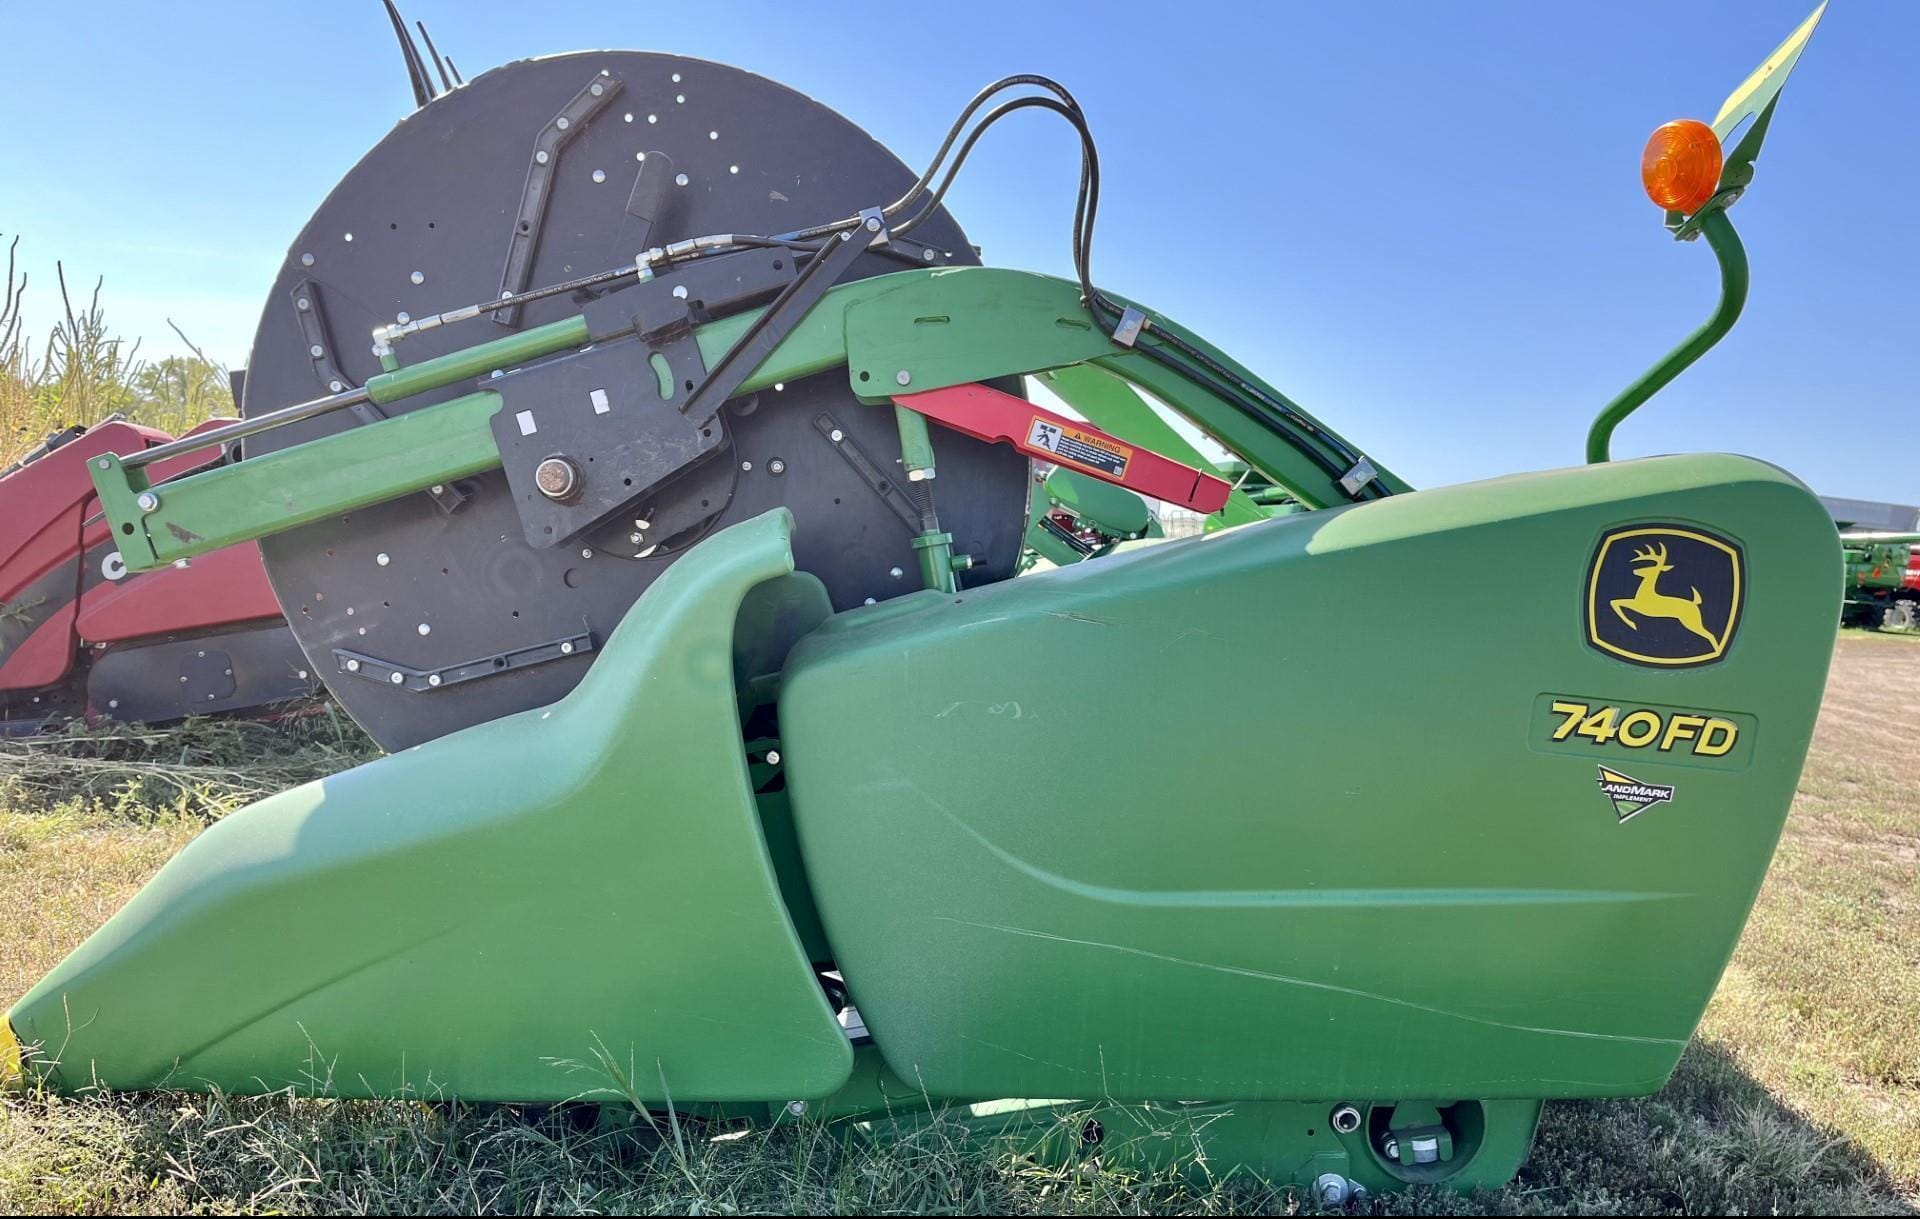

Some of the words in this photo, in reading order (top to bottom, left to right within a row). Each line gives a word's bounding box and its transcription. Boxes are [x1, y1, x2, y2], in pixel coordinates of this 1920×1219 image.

[1084, 434, 1121, 454] WARNING
[1551, 700, 1738, 756] 740FD
[1613, 793, 1654, 803] IMPLEMENT
